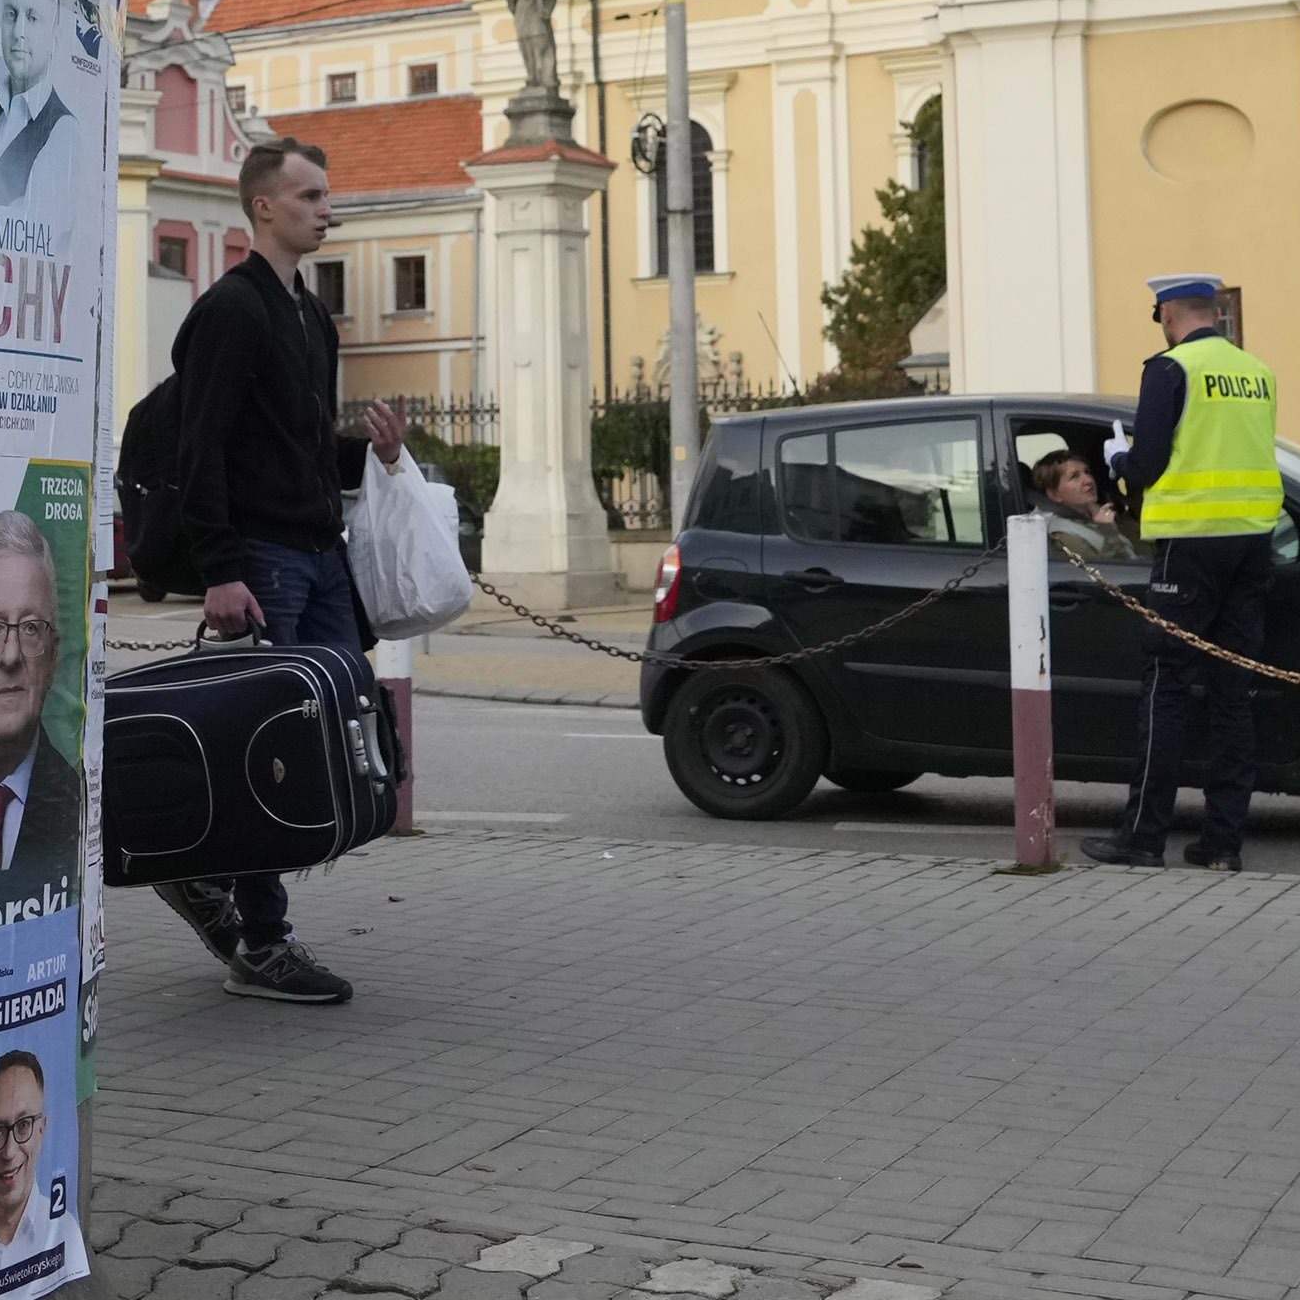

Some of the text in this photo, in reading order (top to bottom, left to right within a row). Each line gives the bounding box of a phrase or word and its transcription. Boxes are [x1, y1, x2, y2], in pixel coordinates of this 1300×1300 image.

[1204, 374, 1271, 400] POLICJA
[0, 392, 8, 410] W
[11, 393, 57, 414] DZIAŁANIU
[40, 476, 84, 497] TRZECIA
[44, 502, 84, 522] DROGA
[1151, 583, 1179, 594] POLICJA
[26, 953, 66, 984] ARTUR
[52, 1183, 64, 1213] 2
